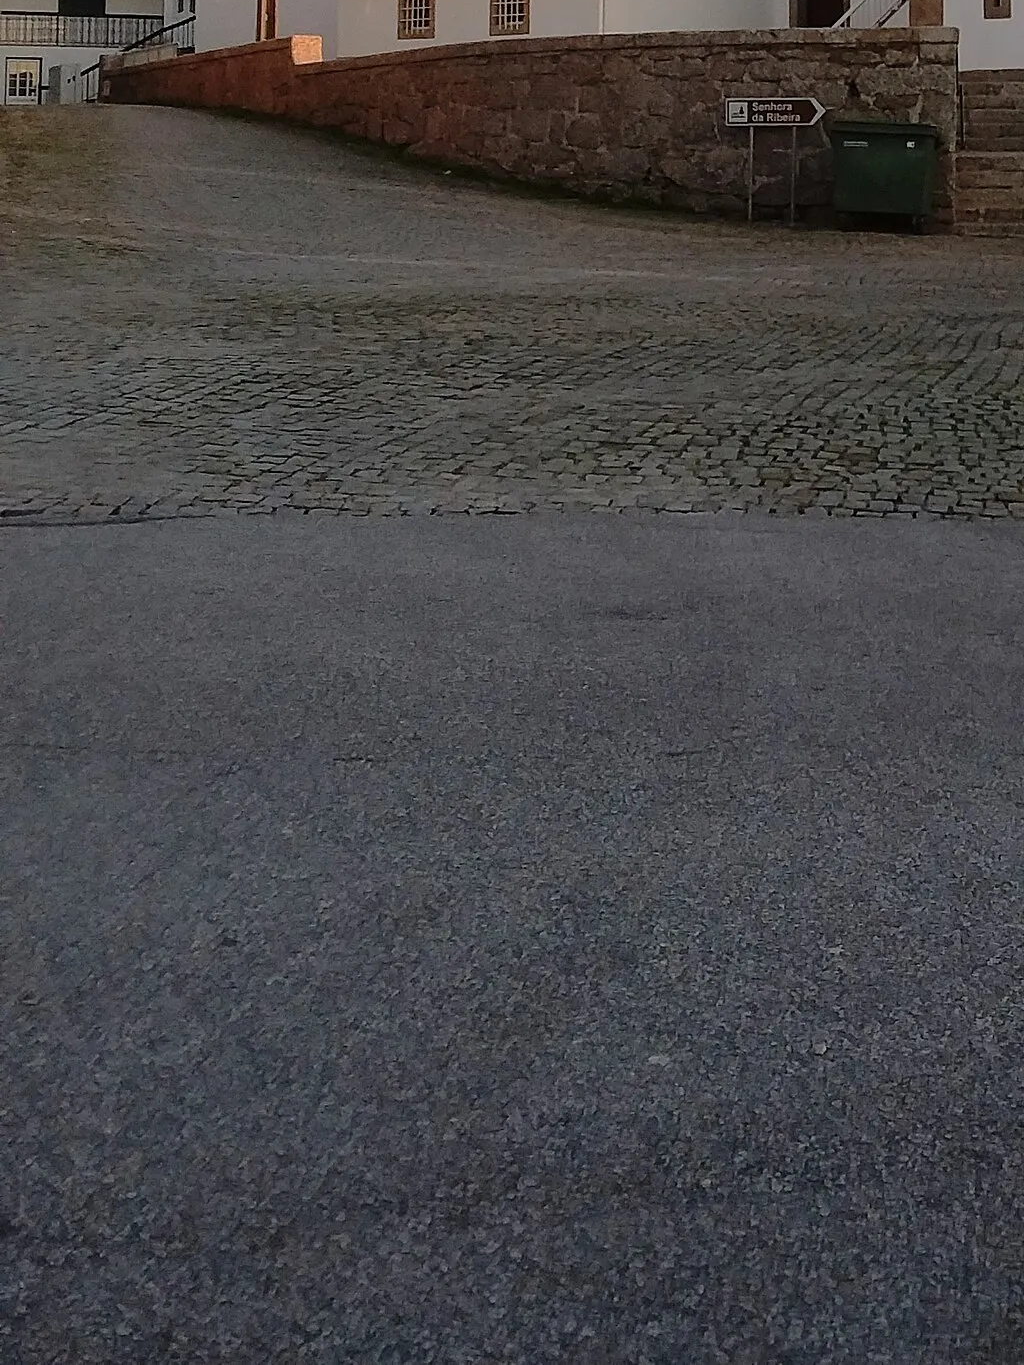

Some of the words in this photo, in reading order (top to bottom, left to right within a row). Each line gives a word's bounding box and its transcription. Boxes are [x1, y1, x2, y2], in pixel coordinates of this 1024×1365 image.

[752, 102, 792, 111] Senhora
[752, 113, 763, 122] da
[766, 112, 801, 122] Ribeira
